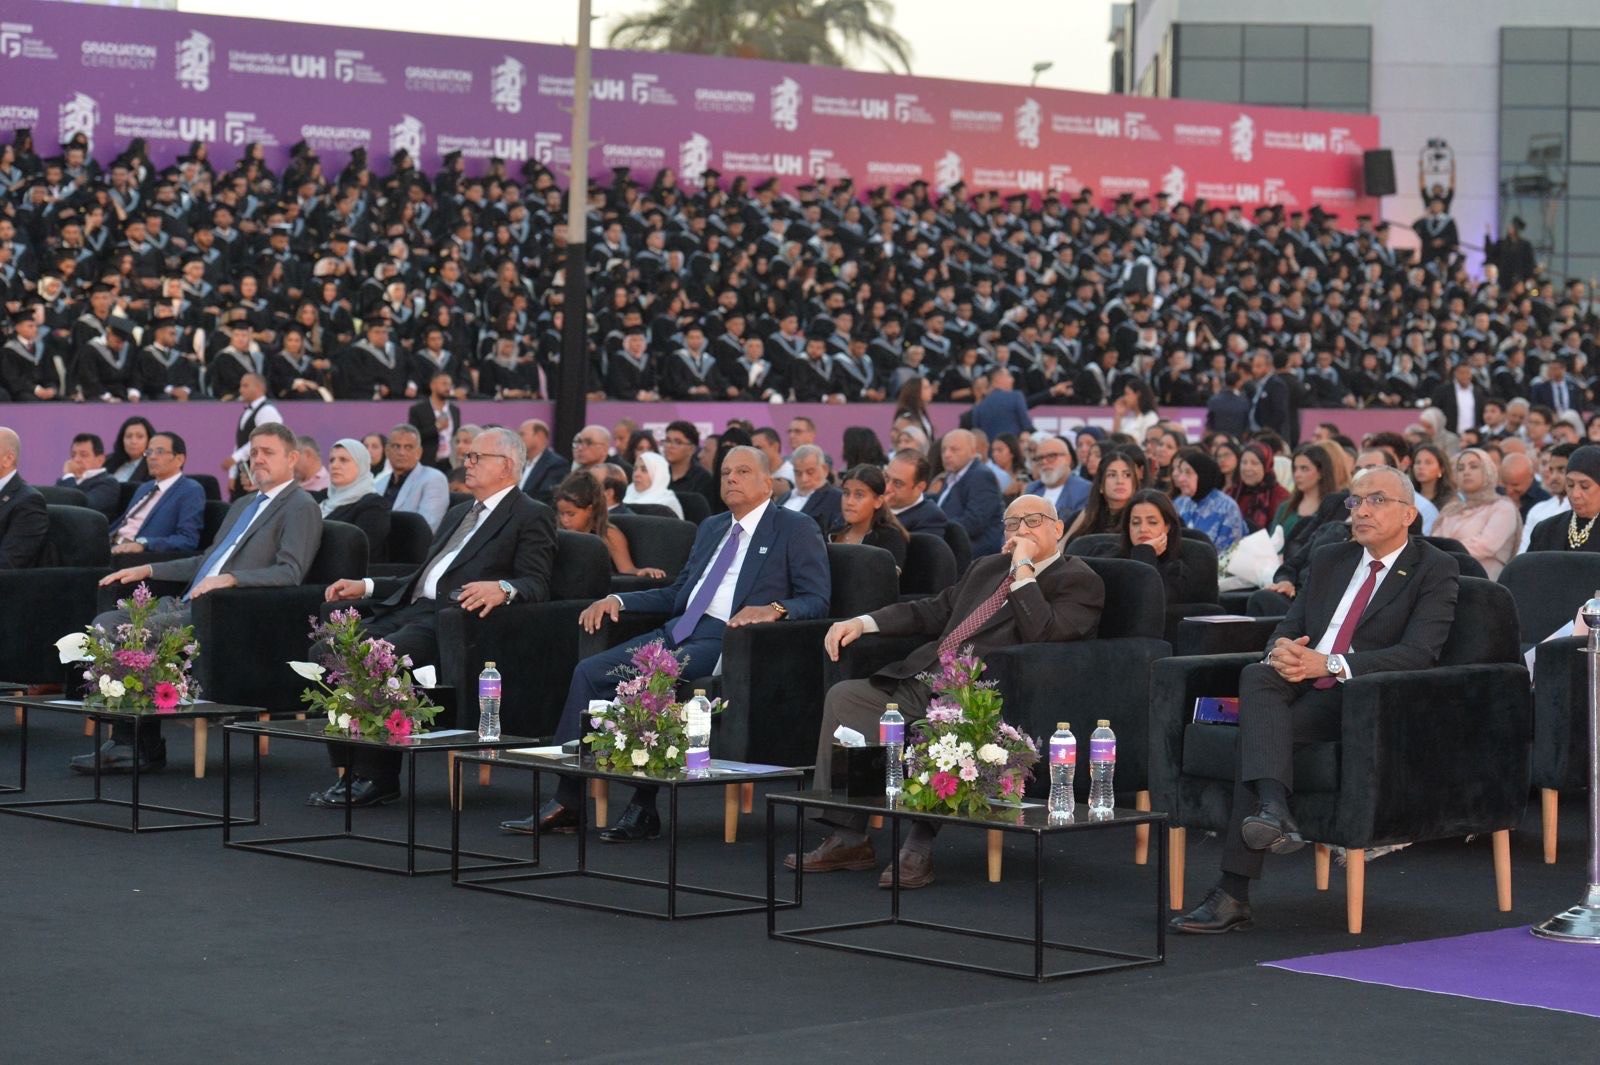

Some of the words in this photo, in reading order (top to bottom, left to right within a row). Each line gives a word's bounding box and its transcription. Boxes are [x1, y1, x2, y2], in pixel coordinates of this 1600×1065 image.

[81, 40, 157, 58] GRADUATION
[290, 53, 327, 79] UH
[593, 80, 625, 101] UH
[861, 99, 889, 120] UH
[179, 117, 217, 142] UH
[494, 138, 527, 161] UH
[773, 153, 802, 176] UH
